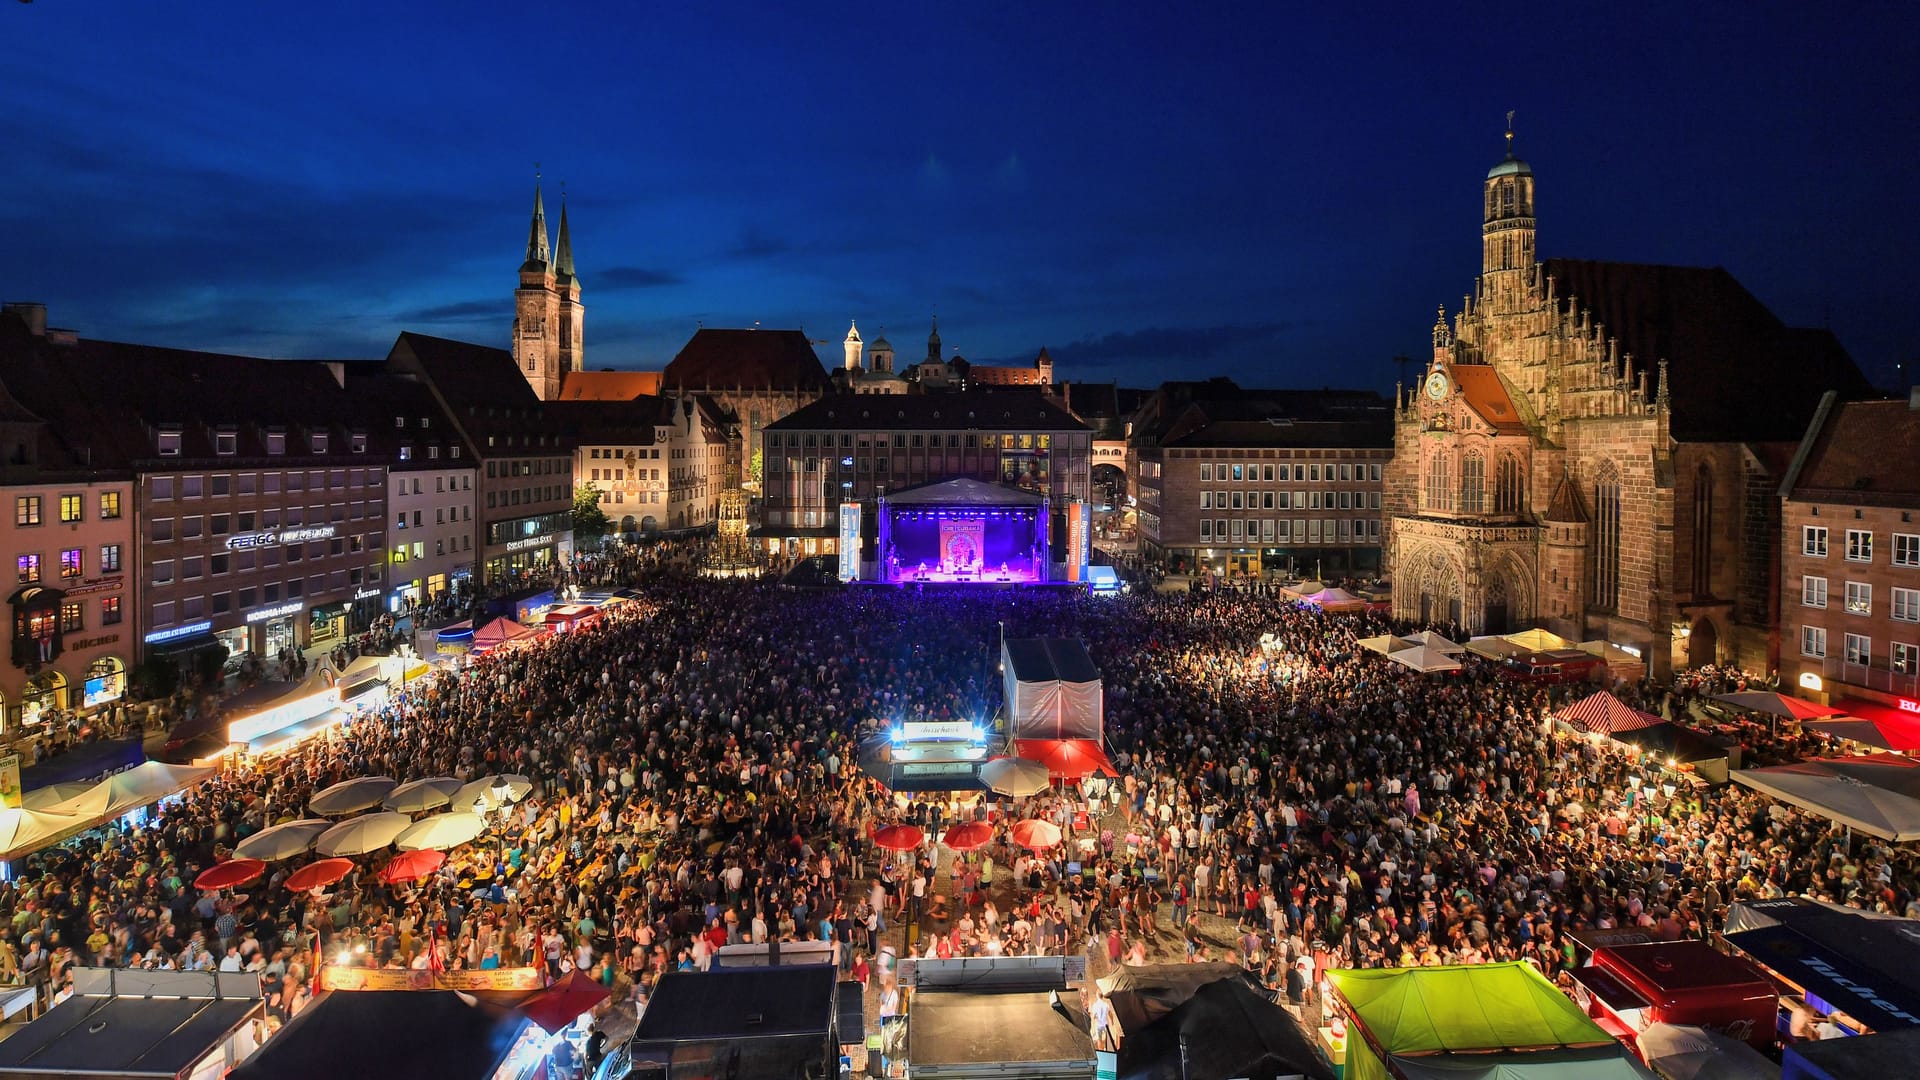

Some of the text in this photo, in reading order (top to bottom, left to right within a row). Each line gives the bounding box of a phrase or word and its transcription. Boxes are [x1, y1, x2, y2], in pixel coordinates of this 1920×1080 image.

[1070, 520, 1079, 566] Willkommen
[1571, 719, 1588, 732] GRILL
[1799, 956, 1920, 1023] Tucher
